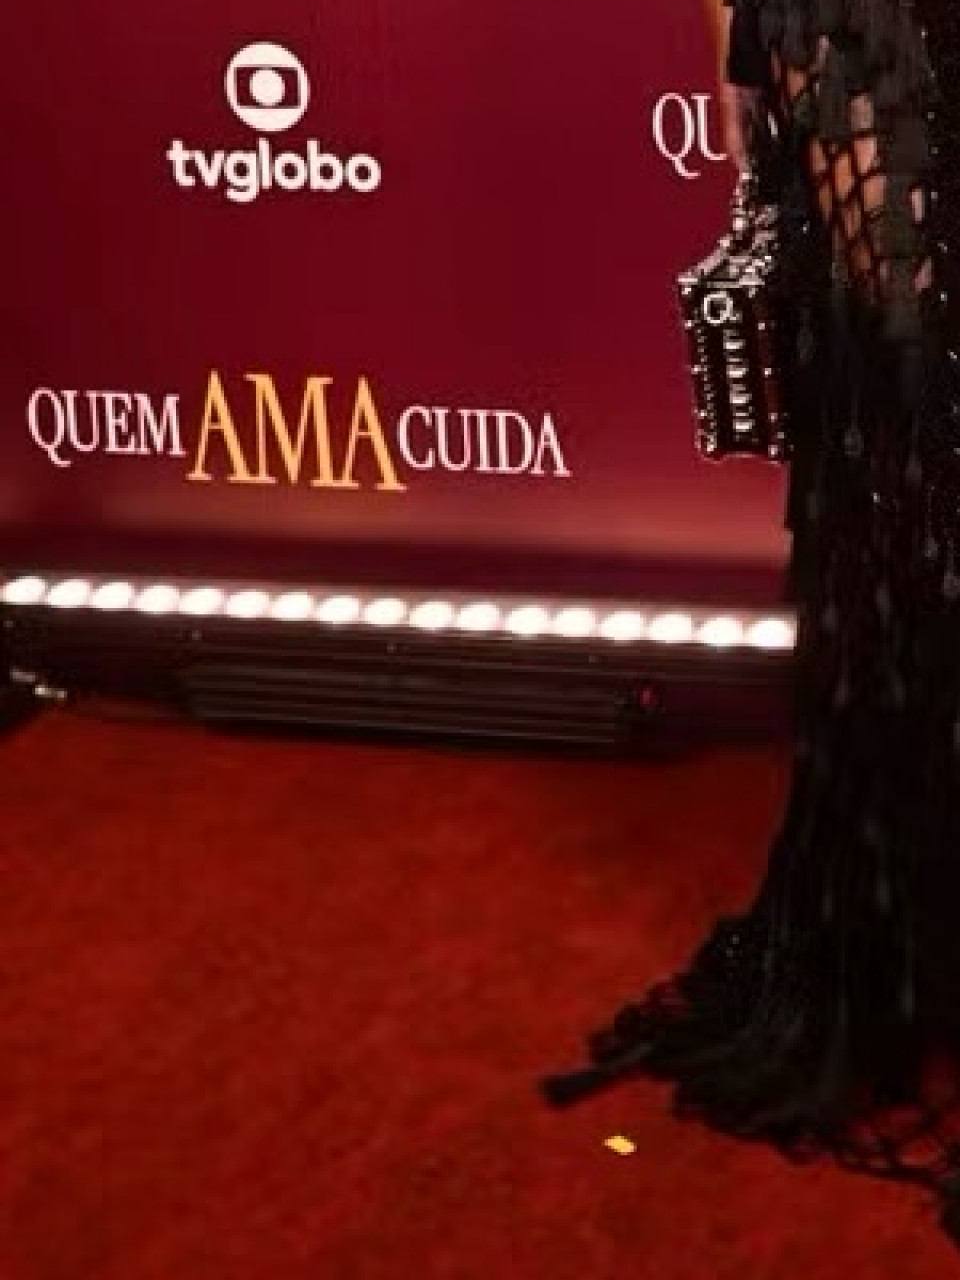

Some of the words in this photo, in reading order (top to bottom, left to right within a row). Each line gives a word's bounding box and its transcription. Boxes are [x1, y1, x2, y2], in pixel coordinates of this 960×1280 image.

[167, 137, 382, 203] tvglobo
[27, 388, 186, 468] QUEM
[187, 370, 408, 492] AMA
[398, 404, 572, 478] CUIDA
